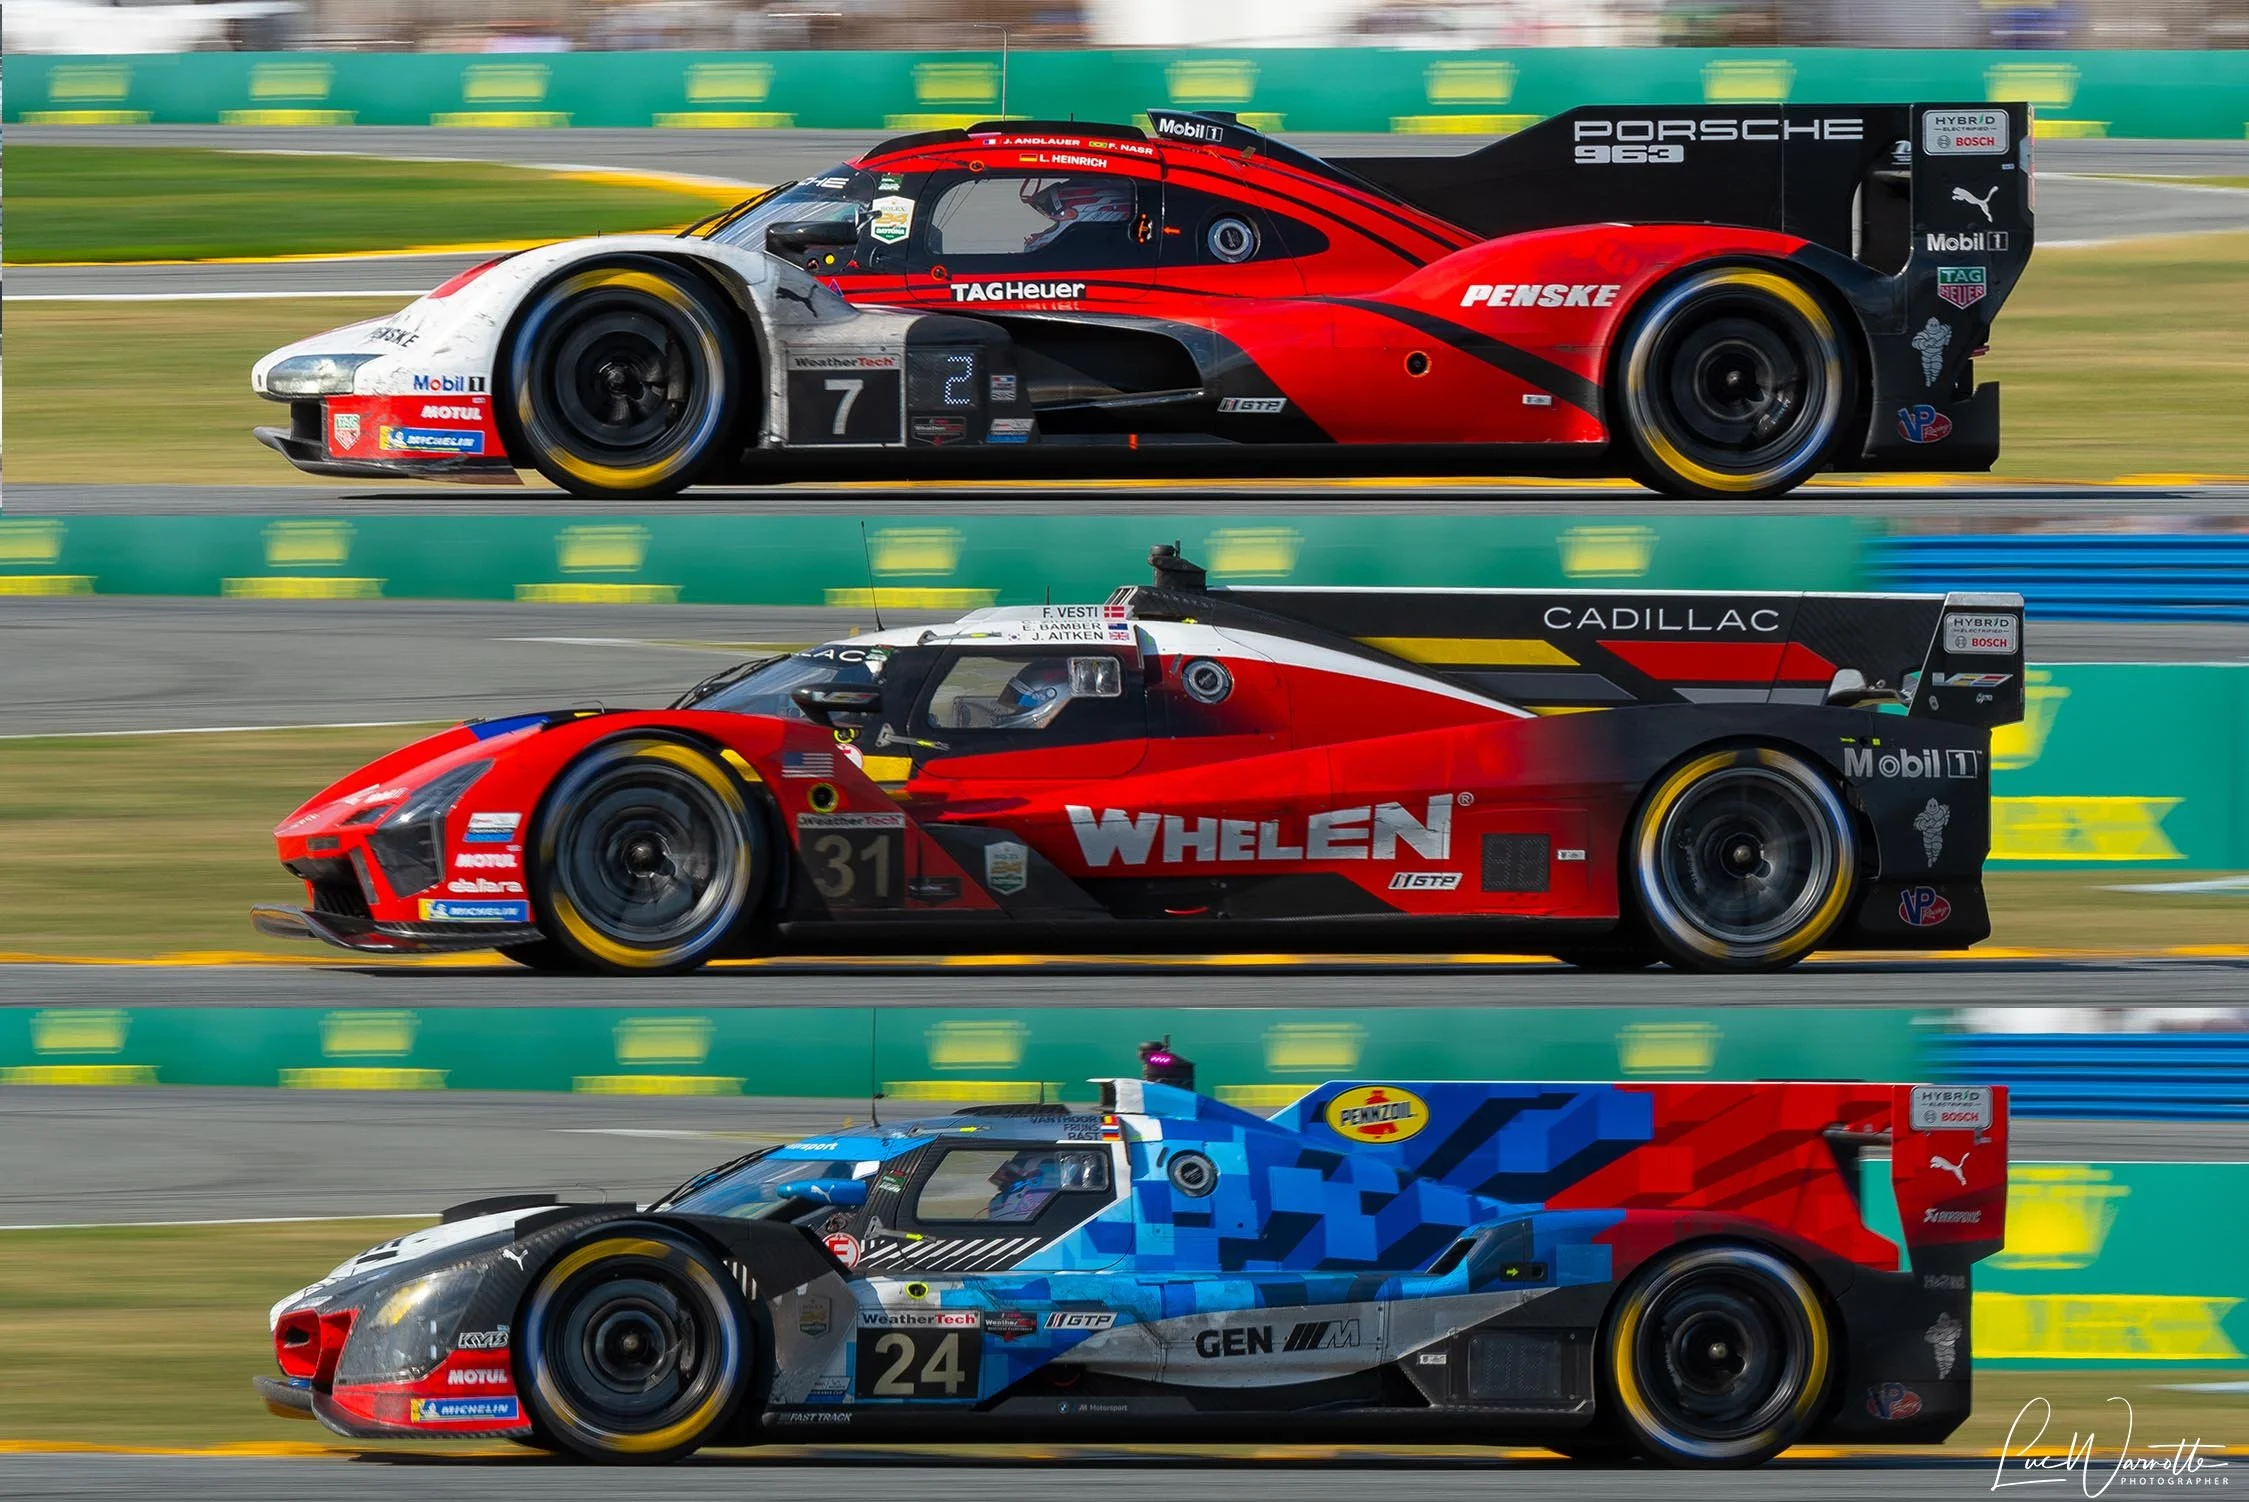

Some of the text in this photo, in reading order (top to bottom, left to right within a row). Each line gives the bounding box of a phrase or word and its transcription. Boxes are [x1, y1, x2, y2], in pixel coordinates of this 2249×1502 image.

[1935, 113, 1996, 125] HYBRID
[1159, 117, 1206, 138] Mobil
[1574, 119, 1863, 142] PORSCHE
[1014, 138, 1080, 146] ANDLAUER
[1956, 136, 1995, 147] BOSCH
[1121, 144, 1153, 155] NASR
[1574, 145, 1685, 163] 963
[1039, 153, 1107, 169] L. HEINRICH
[1926, 232, 1985, 251] Mobil
[1941, 270, 1982, 282] TAG
[1460, 285, 1620, 307] PENSKE
[1939, 286, 1984, 306] HEUER
[795, 356, 896, 367] WeatherTech
[413, 375, 464, 391] Mobil
[945, 356, 973, 404] 2
[421, 405, 482, 420] MOTUL
[824, 379, 864, 435] 7
[1240, 400, 1281, 411] GTP
[1897, 404, 1937, 442] VP
[1043, 606, 1098, 618] F. VESTI
[1543, 606, 1781, 632] CADILLAC
[1039, 621, 1101, 631] BAMBER
[1953, 618, 2010, 628] HYBRID
[1032, 631, 1104, 641] J. AITKEN
[1972, 638, 2008, 648] BOSCH
[1843, 747, 1941, 779] Mobil
[455, 853, 518, 868] MOTUL
[814, 834, 890, 898] 31
[1412, 865, 1457, 886] GTP
[1900, 885, 1937, 924] VP
[1922, 1090, 1980, 1101] HYBRID
[1340, 1100, 1418, 1128] PENNZOIL
[1941, 1112, 1979, 1121] BOSCH
[1067, 1132, 1099, 1140] RAST
[863, 1312, 977, 1324] WeatherTech
[1067, 1315, 1111, 1326] GTP
[458, 1331, 509, 1348] KYB
[1196, 1325, 1273, 1358] GEN
[873, 1332, 965, 1395] 24
[448, 1369, 507, 1385] MOTUL
[441, 1404, 509, 1415] MICHELIN
[790, 1412, 852, 1422] FAST TRACK
